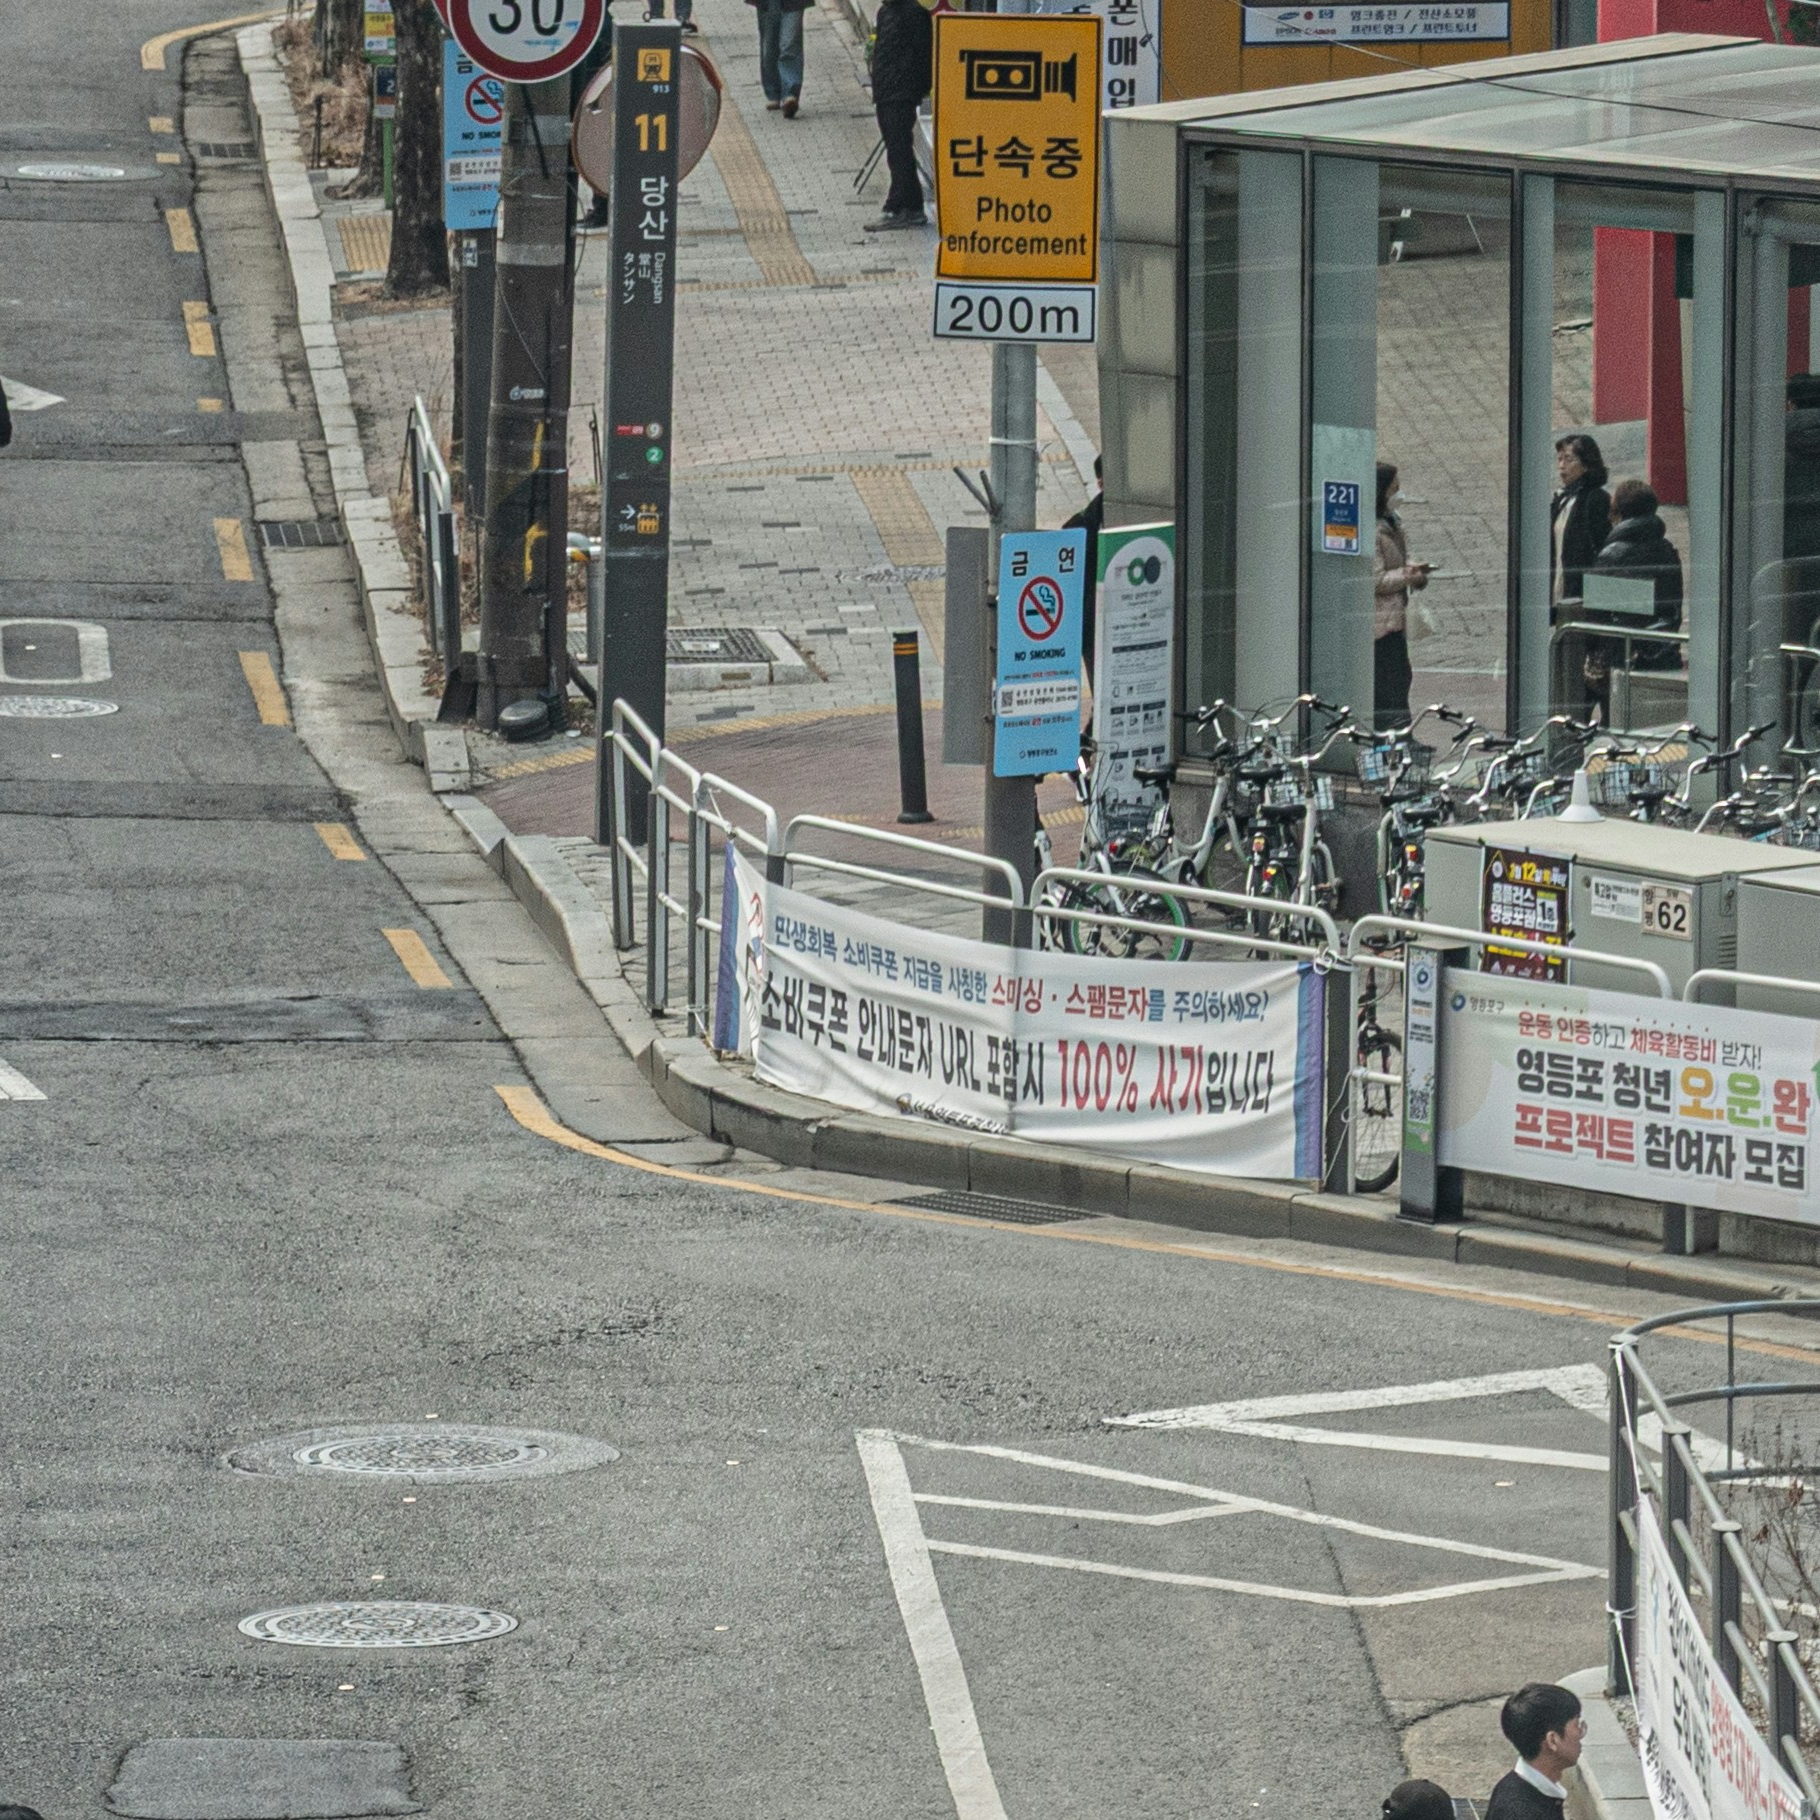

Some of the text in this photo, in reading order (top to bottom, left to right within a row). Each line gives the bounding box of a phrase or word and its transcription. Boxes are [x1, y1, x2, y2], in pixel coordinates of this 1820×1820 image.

[635, 113, 668, 151] 11
[949, 134, 1083, 180] 단속중
[639, 176, 669, 240] 당산
[977, 196, 1052, 223] Photo
[947, 230, 1087, 257] enforcement
[949, 294, 1080, 335] 200m
[1328, 485, 1355, 505] 221
[1014, 648, 1066, 662] NO SMOKING
[1658, 901, 1687, 933] 62
[775, 915, 838, 962] 민생회복
[843, 937, 898, 981] 소비쿠폰
[903, 956, 943, 994] 지급을
[948, 967, 988, 1004] 사칭한
[992, 975, 1044, 1014] 스미싱
[1065, 983, 1166, 1022] 스팸문자를
[1172, 989, 1270, 1023] 주의하세요!
[761, 970, 849, 1053] 소비쿠폰
[857, 997, 934, 1079] 안내문자
[939, 1022, 982, 1093] URL
[1058, 1039, 1139, 1113] 100%
[1150, 1044, 1275, 1115] 사기입니다
[1518, 1010, 1763, 1071] 운동 인증하고 체육활동비 받자!
[1516, 1048, 1605, 1103] 영등포
[1613, 1061, 1671, 1114] 청년
[1514, 1102, 1805, 1190] 프로젝트 참여자 모집
